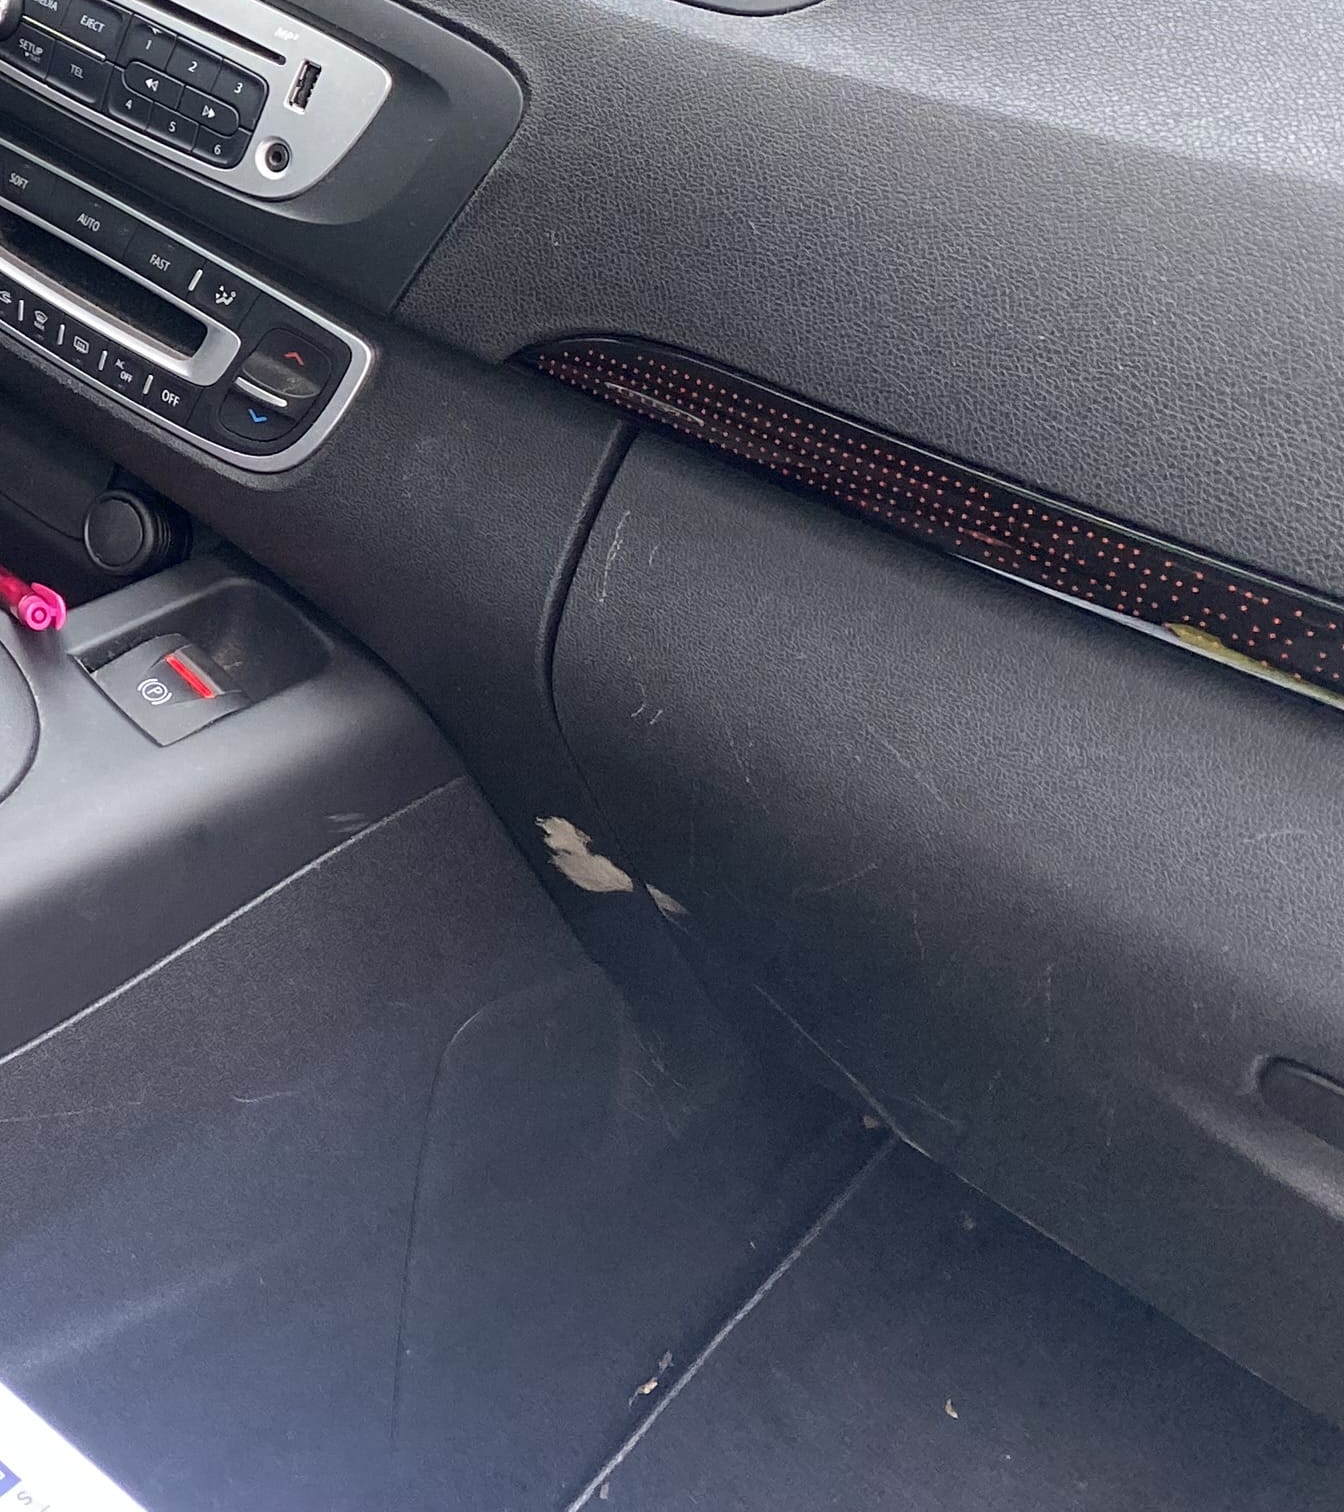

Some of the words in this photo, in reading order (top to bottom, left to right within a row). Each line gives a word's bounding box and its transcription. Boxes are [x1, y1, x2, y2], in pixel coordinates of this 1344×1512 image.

[80, 14, 105, 33] EJECT
[18, 38, 44, 56] SETUP
[145, 39, 152, 50] 1
[70, 63, 84, 79] TEL
[187, 61, 198, 73] 2
[233, 82, 244, 94] 3
[124, 99, 133, 110] 4
[168, 121, 177, 133] 5
[213, 143, 222, 155] 6
[9, 172, 29, 190] SOFT
[76, 212, 102, 232] AUTO
[149, 253, 171, 272] FAST
[120, 371, 133, 383] OFF
[161, 389, 181, 407] OFF
[17, 1490, 33, 1506] S
